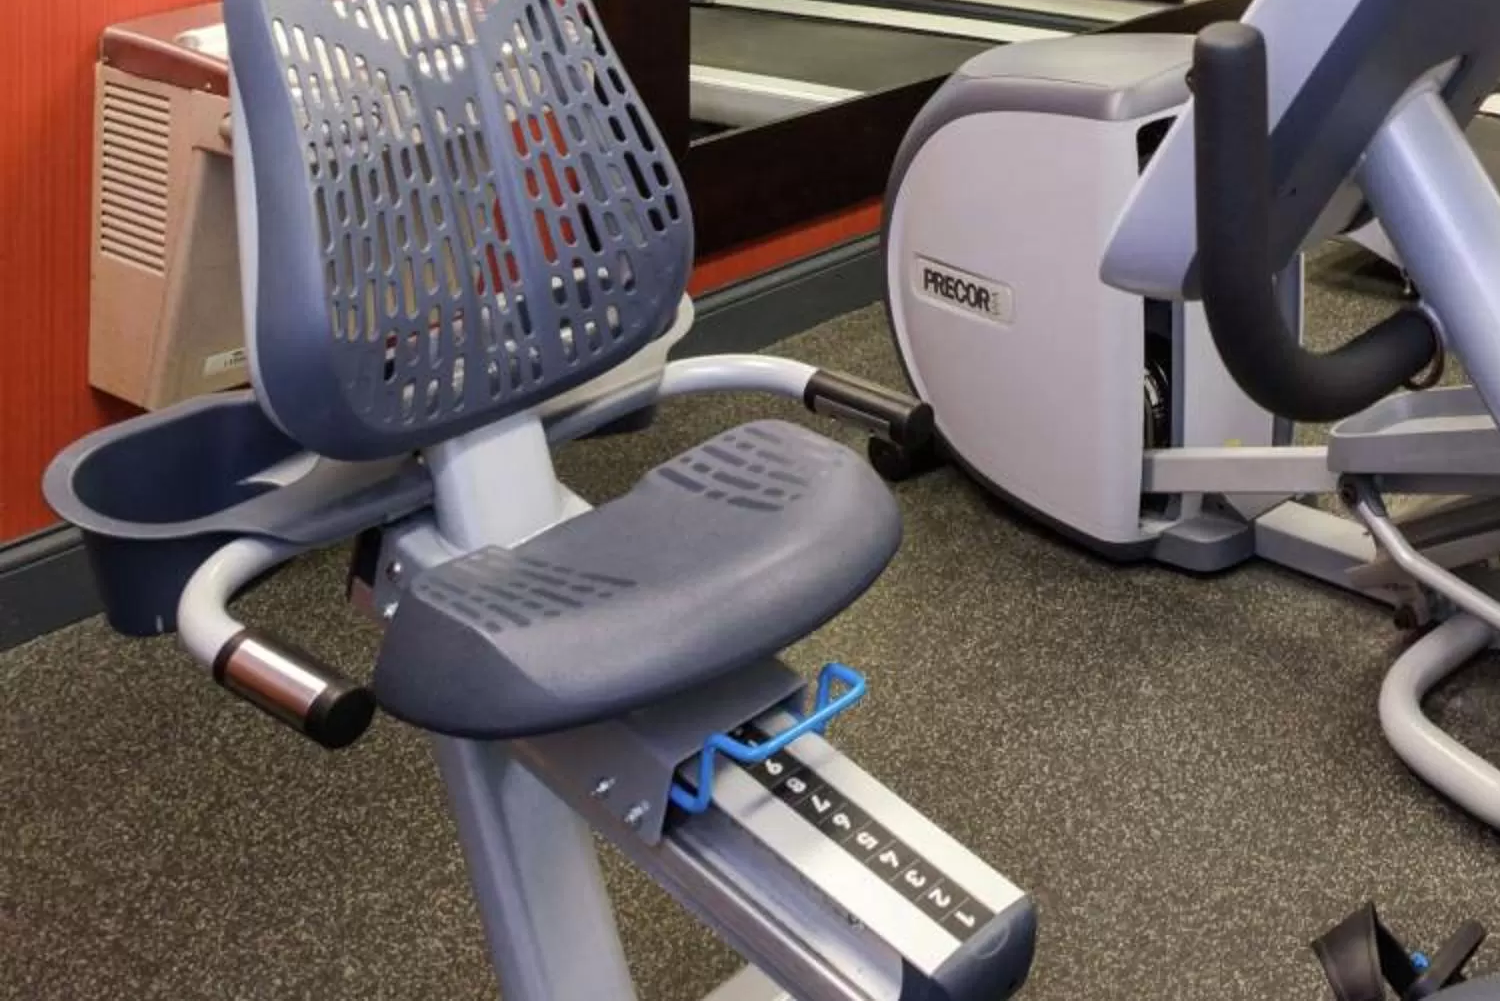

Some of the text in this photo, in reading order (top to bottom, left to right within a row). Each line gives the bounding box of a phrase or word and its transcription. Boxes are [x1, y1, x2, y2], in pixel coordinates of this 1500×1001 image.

[923, 267, 990, 312] PRECOR
[786, 776, 807, 793] 8
[810, 795, 831, 813] 7
[832, 812, 851, 830] 6
[856, 832, 878, 850] 5
[879, 850, 900, 868] 4
[905, 869, 926, 888] 3
[928, 888, 951, 908] 2
[954, 910, 976, 928] 1
